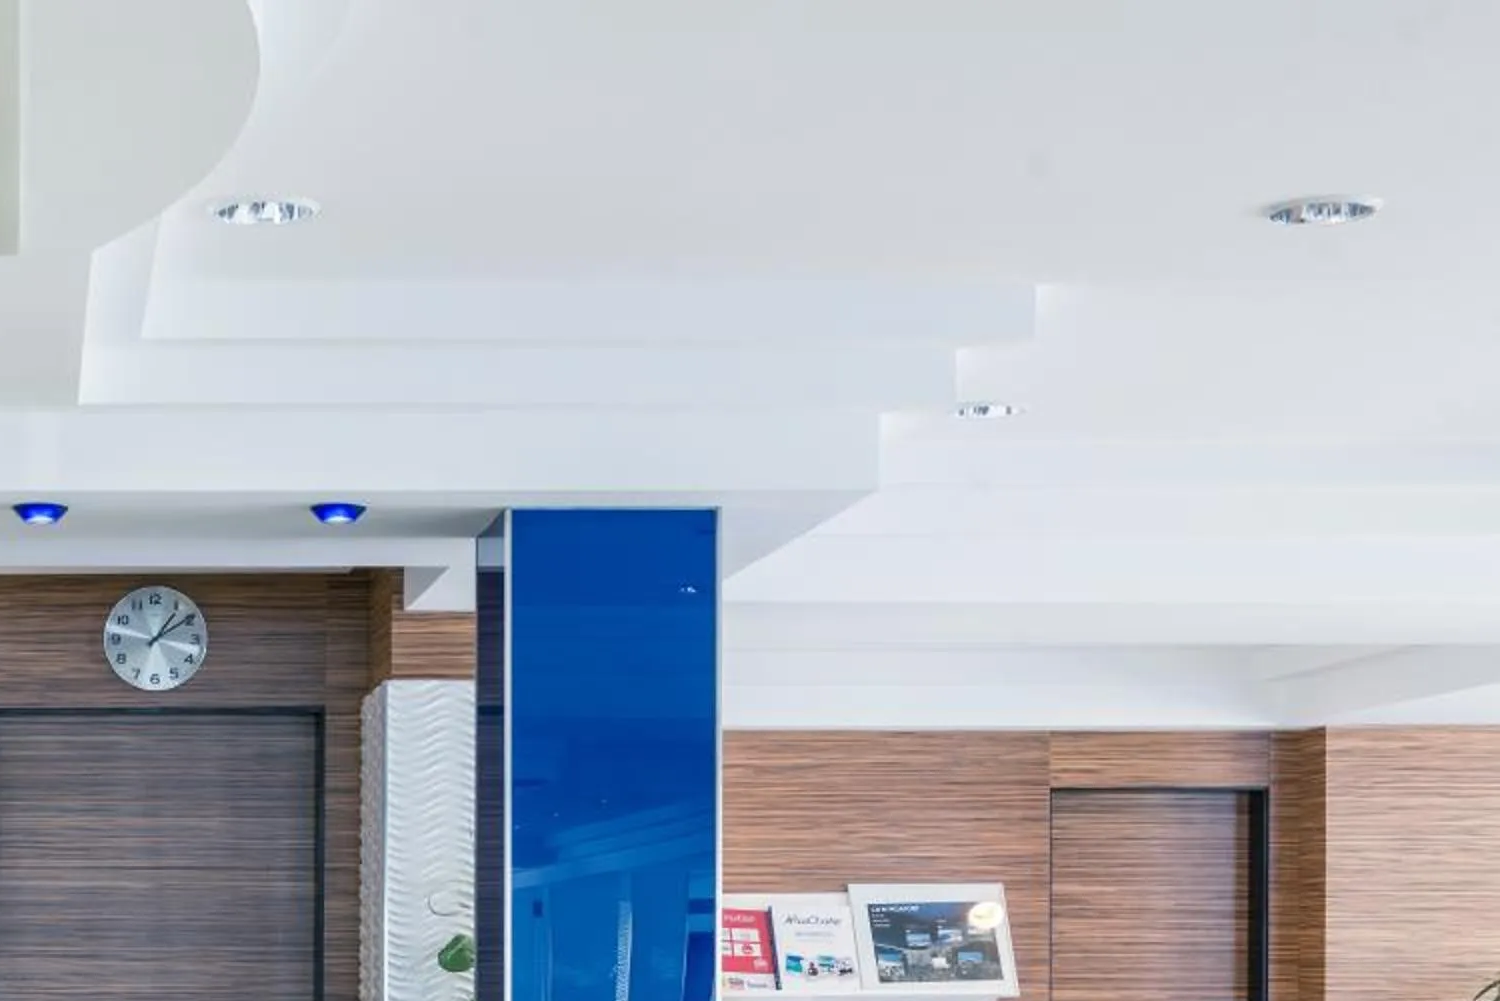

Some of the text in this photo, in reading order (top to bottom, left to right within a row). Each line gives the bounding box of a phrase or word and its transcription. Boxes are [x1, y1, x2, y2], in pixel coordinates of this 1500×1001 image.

[149, 593, 162, 605] 12
[132, 600, 143, 610] 11
[174, 601, 178, 611] 1
[117, 615, 129, 625] 10
[184, 615, 195, 626] 2
[111, 634, 121, 644] 9
[190, 633, 200, 645] 3
[116, 653, 126, 664] 8
[184, 653, 193, 664] 4
[132, 668, 141, 679] 7
[150, 673, 160, 684] 6
[169, 667, 179, 679] 5
